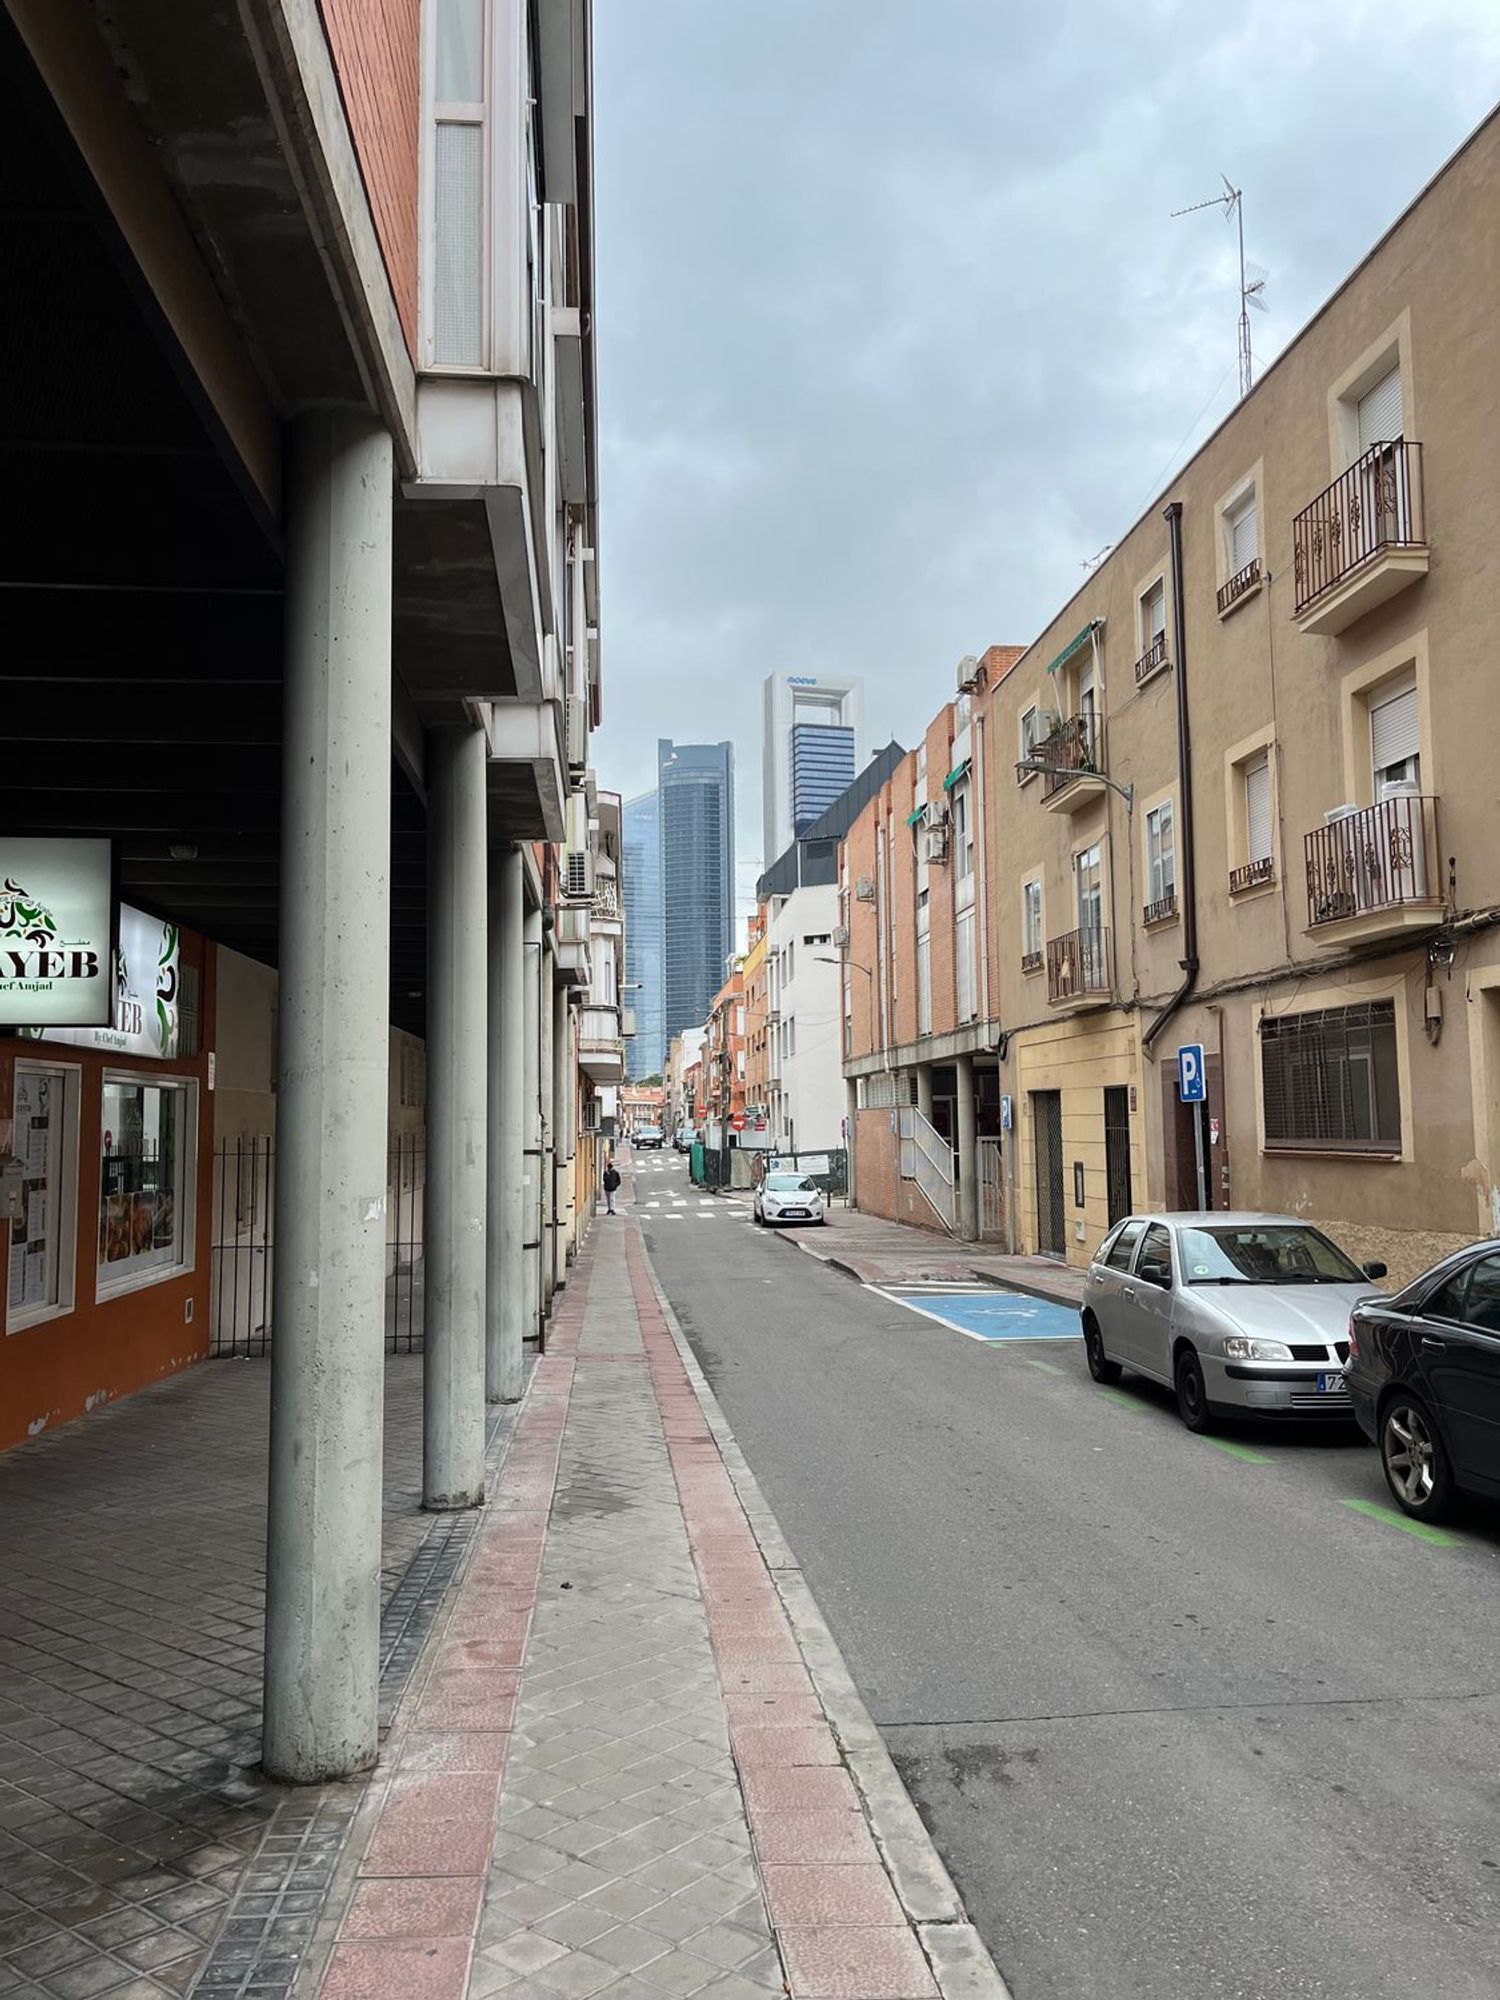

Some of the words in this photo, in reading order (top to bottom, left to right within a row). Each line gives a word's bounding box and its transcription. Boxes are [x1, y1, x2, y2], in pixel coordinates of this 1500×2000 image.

[0, 951, 98, 978] YEB
[16, 981, 52, 992] Amjad
[119, 1001, 142, 1034] EB
[1181, 1053, 1196, 1095] P
[1328, 1376, 1345, 1390] 72
